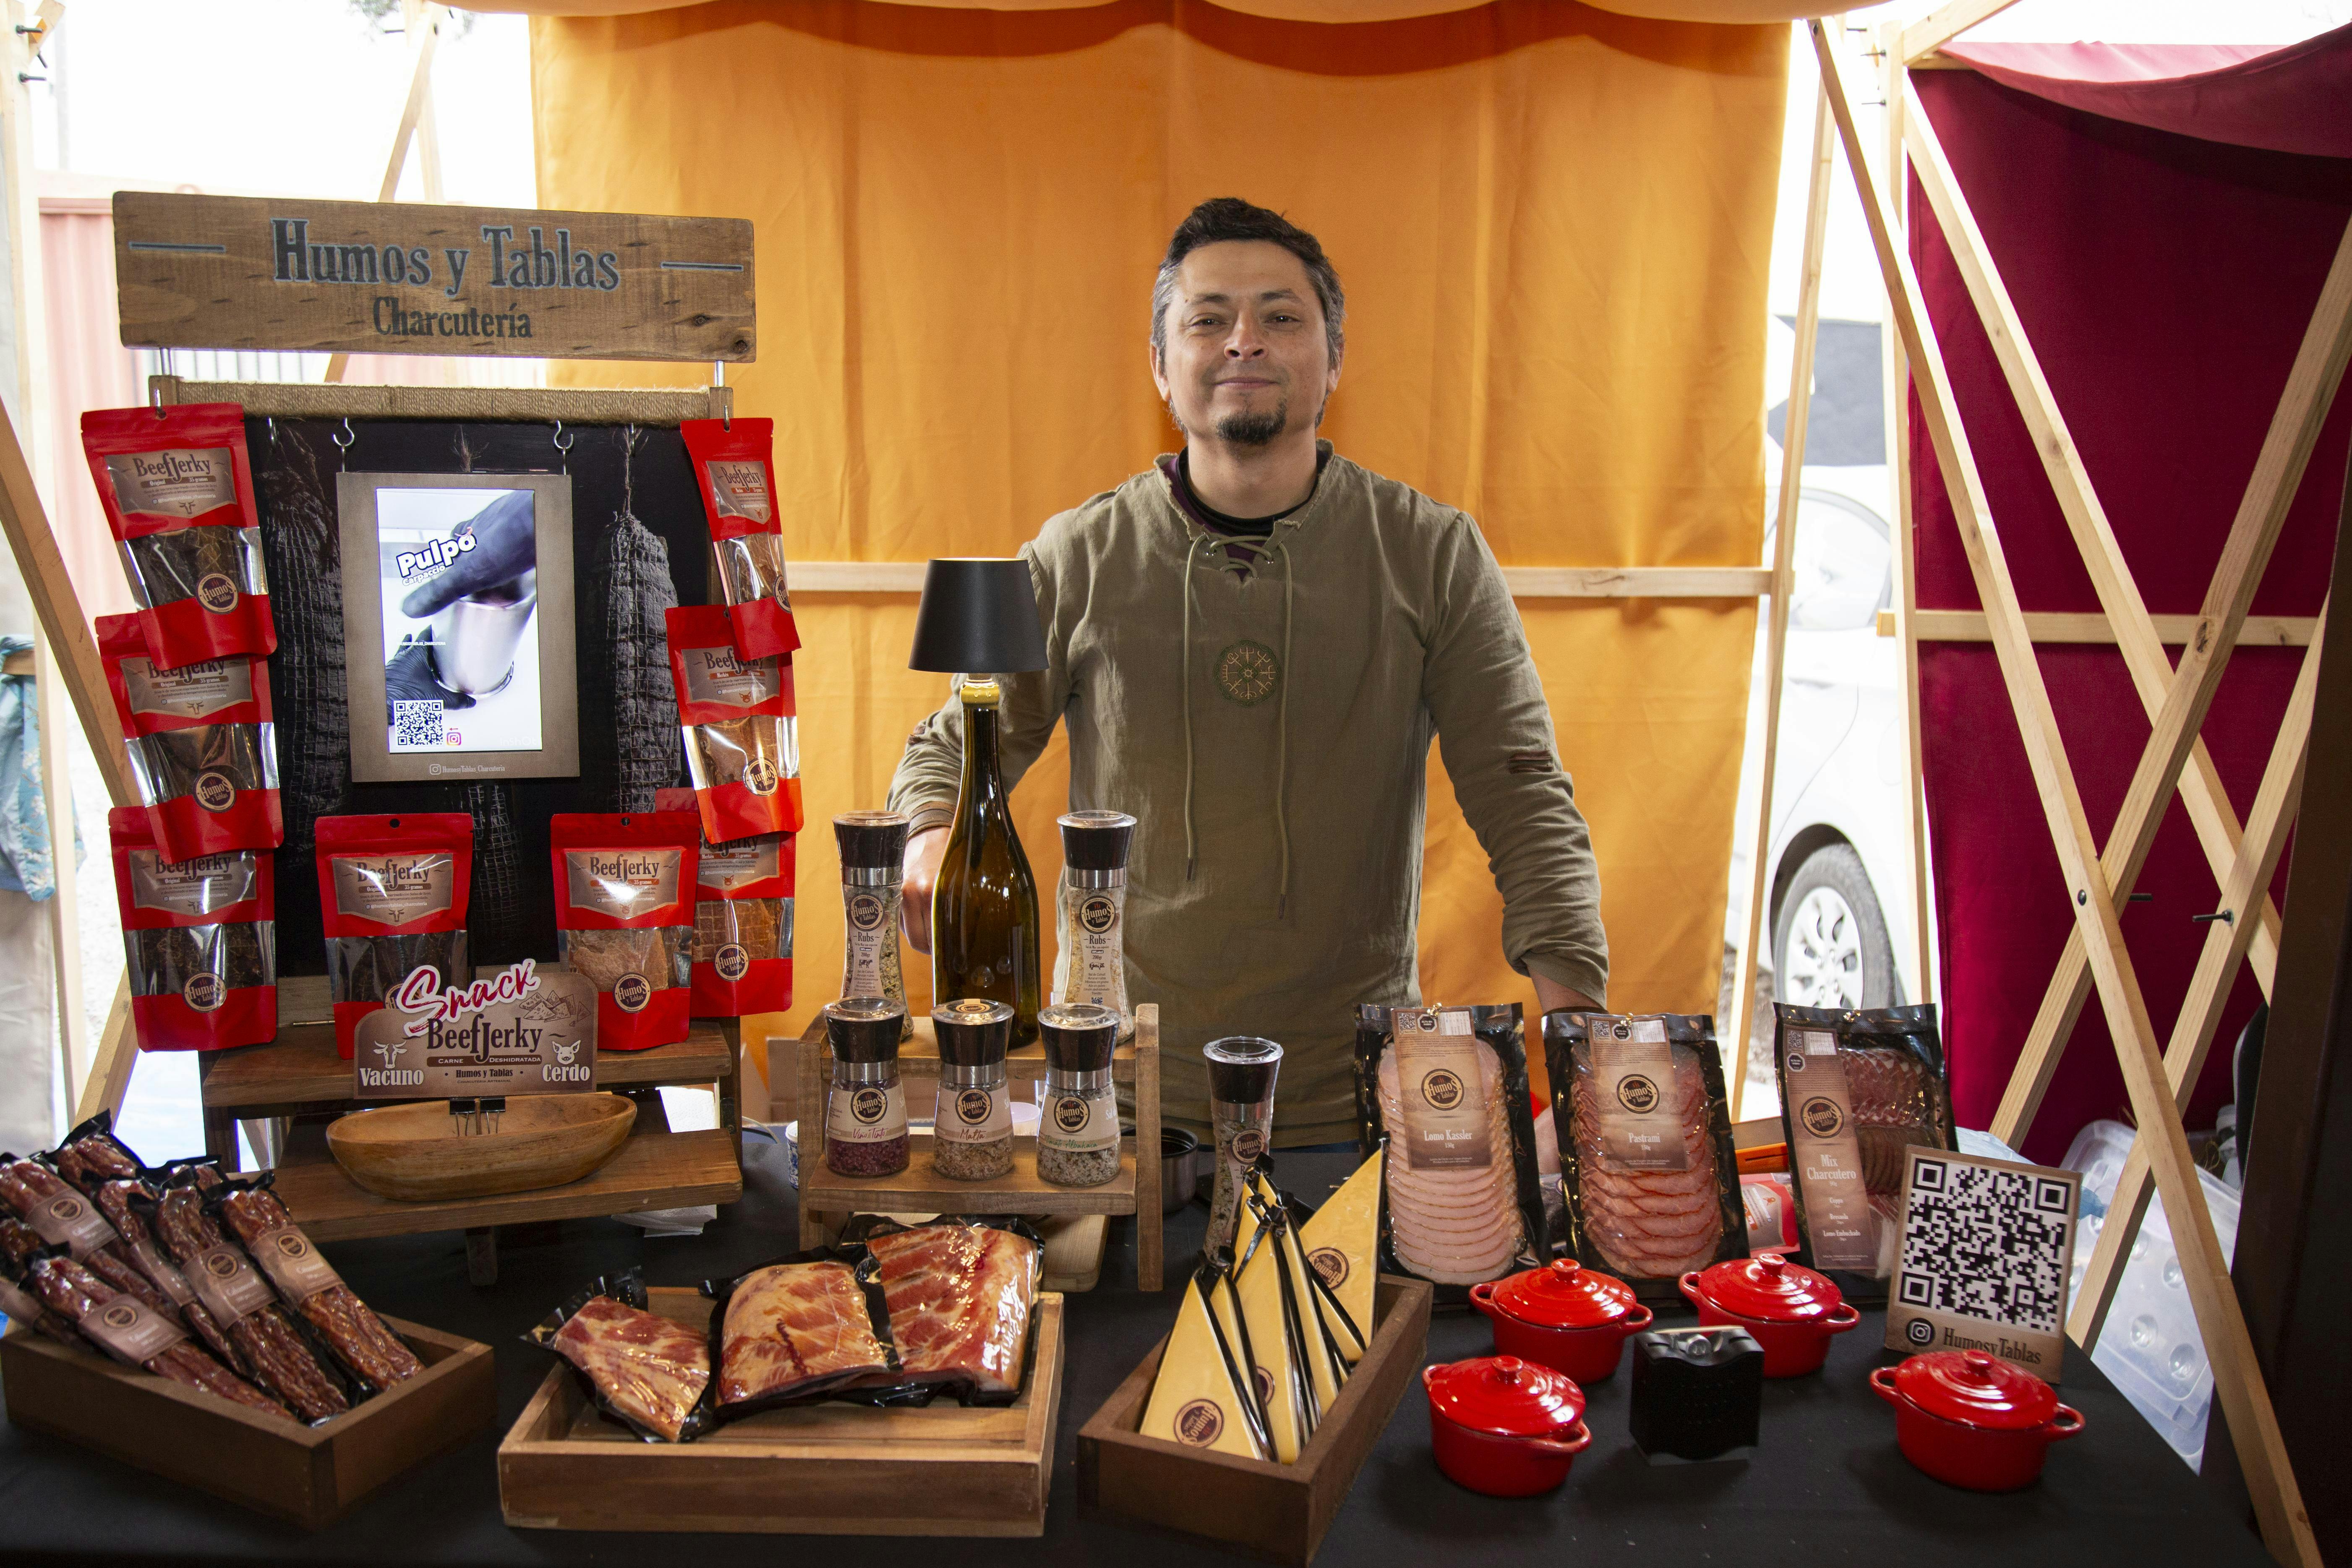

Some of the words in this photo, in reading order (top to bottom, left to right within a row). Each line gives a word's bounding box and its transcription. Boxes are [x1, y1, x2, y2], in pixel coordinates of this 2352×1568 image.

[271, 217, 431, 286] Humos
[444, 248, 470, 297] y
[480, 224, 621, 292] Tablas
[373, 296, 533, 338] Charcutería
[396, 534, 477, 578] Pulpo
[402, 564, 446, 586] Carpaccio
[858, 931, 874, 942] Rubs
[1089, 935, 1106, 944] Rubs
[401, 962, 536, 1033] Snack
[360, 1067, 425, 1086] Vacuno
[456, 1069, 481, 1078] Humos
[483, 1070, 487, 1078] y
[489, 1068, 513, 1077] Tablas
[542, 1064, 590, 1082] Cerdo
[852, 1128, 867, 1139] Vino
[868, 1128, 889, 1139] Tinto
[960, 1128, 987, 1141] Malta
[1424, 1130, 1444, 1141] Lomo
[1446, 1129, 1472, 1141] Kassler
[1628, 1132, 1660, 1143] Pastrami
[1821, 1154, 1838, 1167] Mix
[1807, 1167, 1856, 1180] Charcutero
[1943, 1327, 2042, 1365] HumosyTablas
